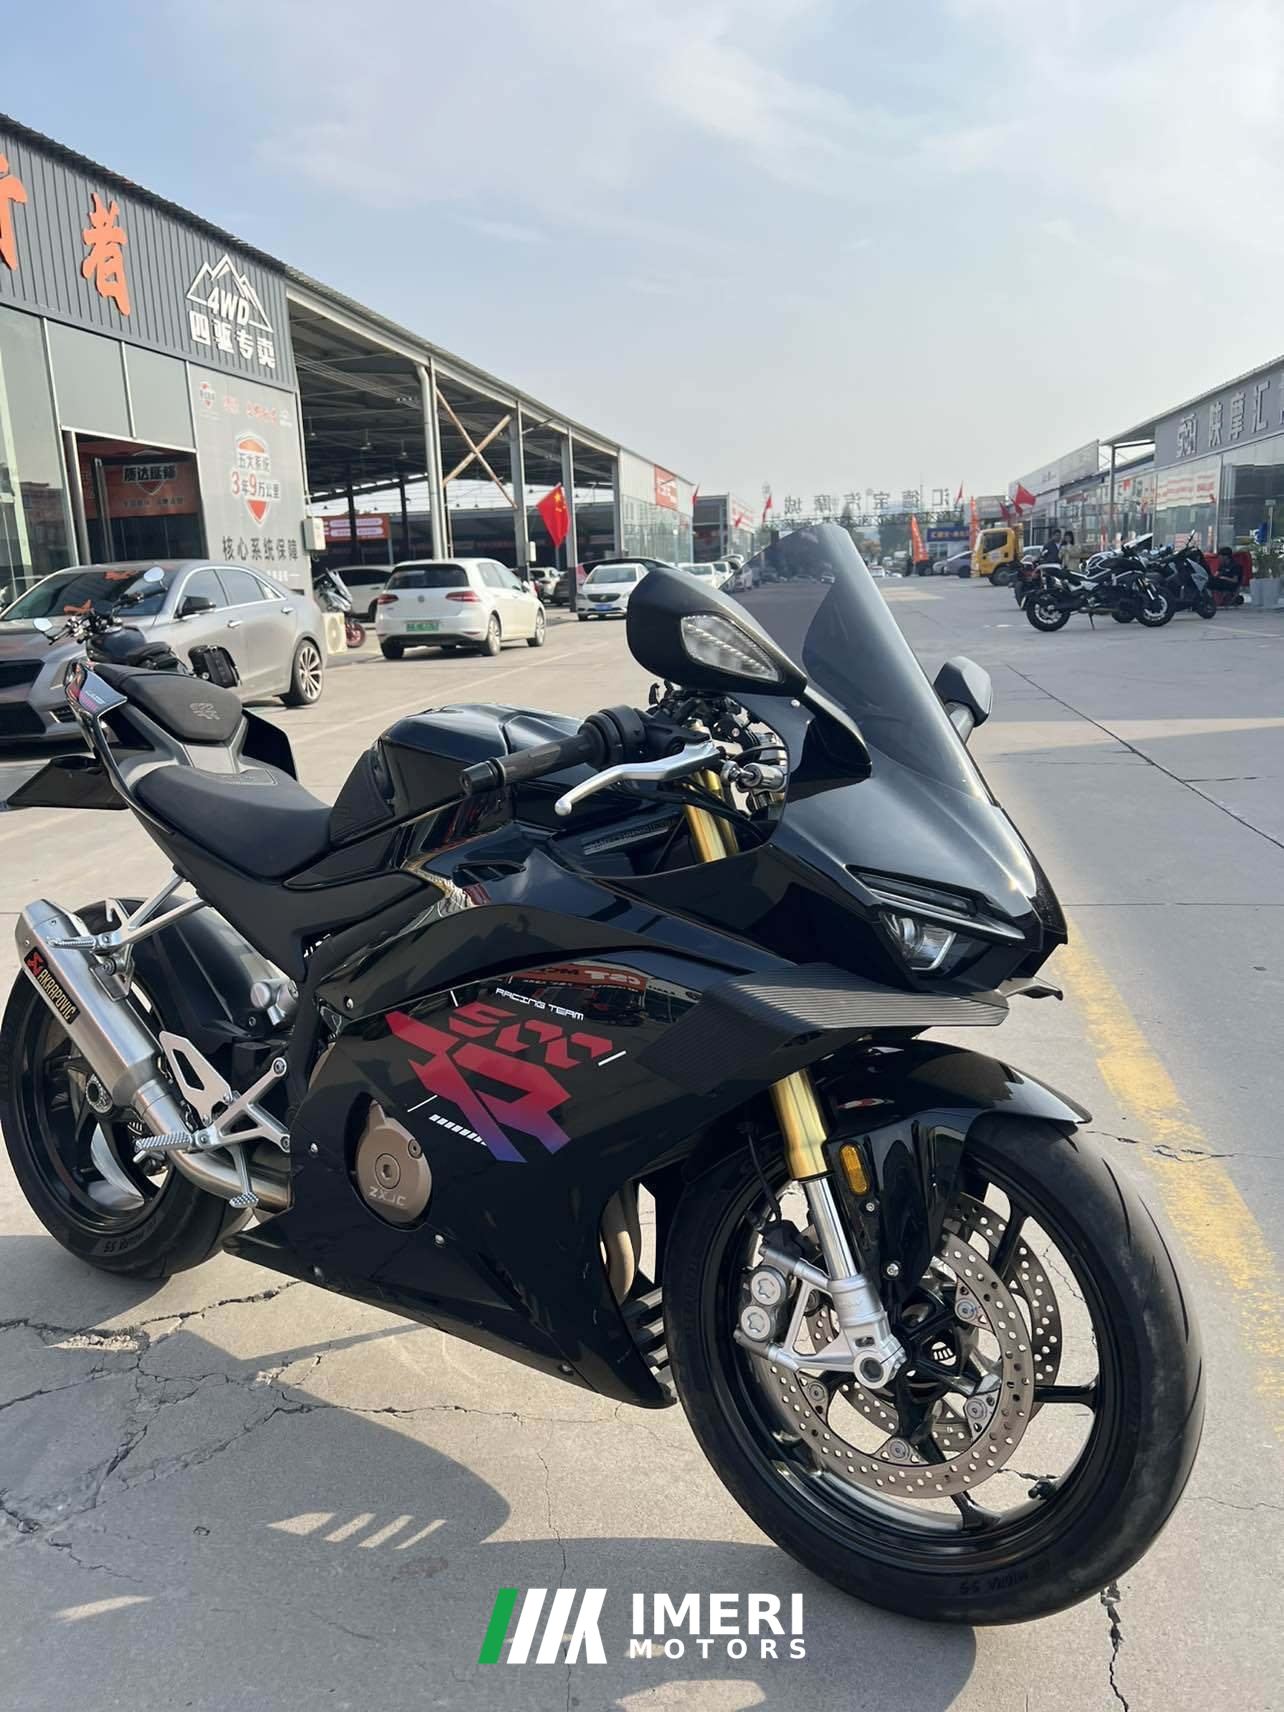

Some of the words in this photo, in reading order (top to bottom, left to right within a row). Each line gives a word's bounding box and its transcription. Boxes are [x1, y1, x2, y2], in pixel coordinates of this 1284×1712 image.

[207, 286, 250, 326] 4WD
[188, 310, 276, 369] 四驱专卖
[222, 535, 299, 561] 核心系统保障
[495, 987, 546, 1011] RACING
[548, 1003, 584, 1021] TEAM
